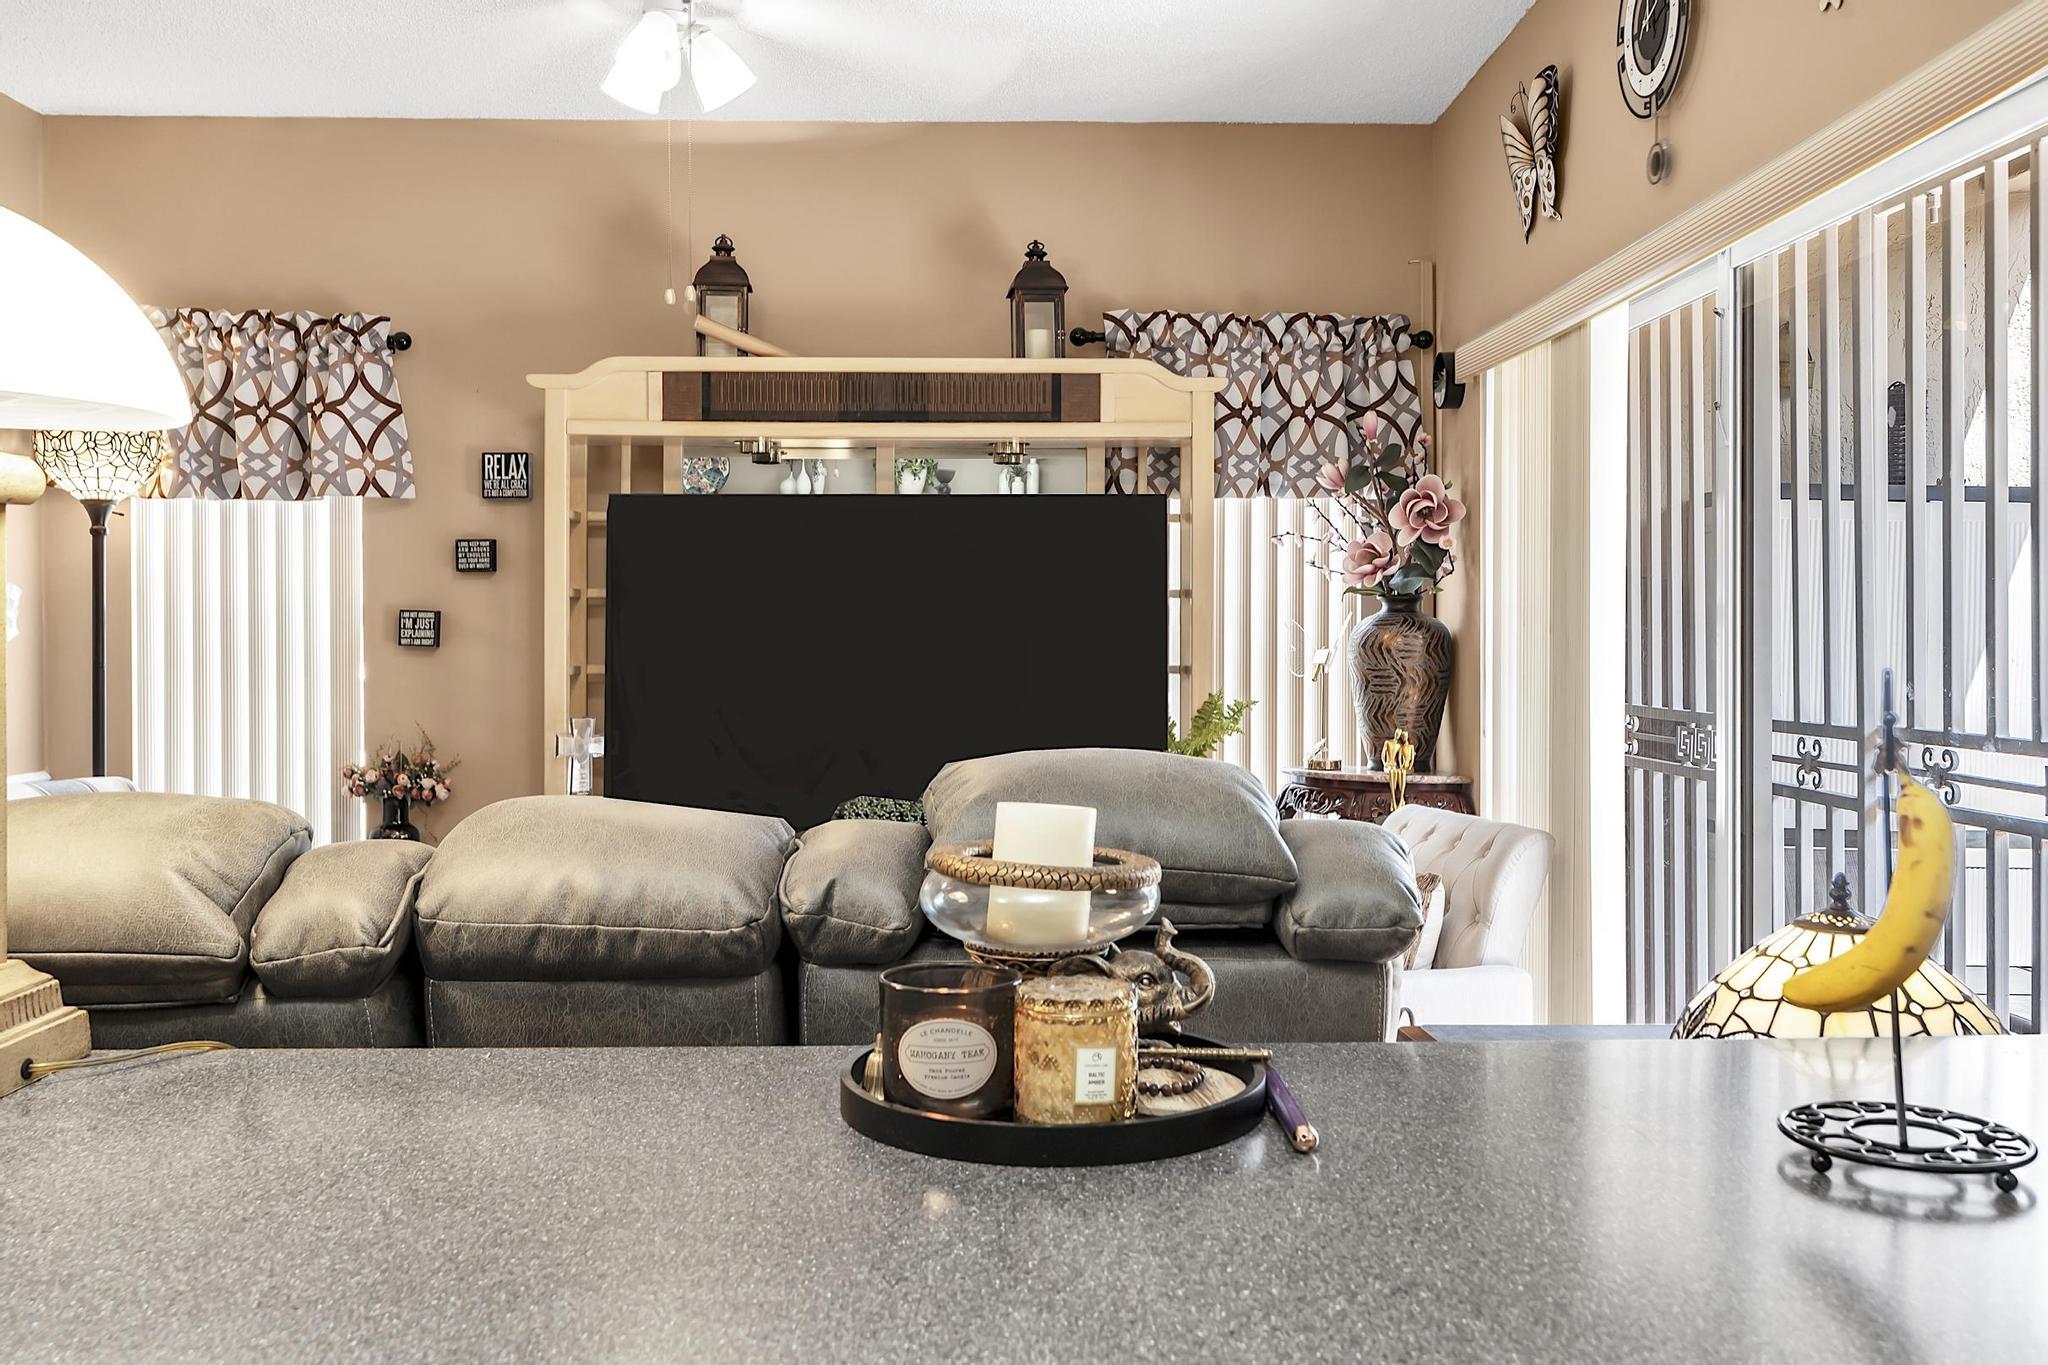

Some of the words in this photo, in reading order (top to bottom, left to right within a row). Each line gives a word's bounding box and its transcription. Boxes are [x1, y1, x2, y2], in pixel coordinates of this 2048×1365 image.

[484, 454, 527, 480] RELAX
[484, 479, 500, 489] WE'RE
[501, 479, 510, 489] ALL
[510, 479, 527, 489] CRAZY
[491, 489, 499, 497] NOT
[401, 618, 413, 629] I'M
[414, 618, 435, 629] JUST
[400, 629, 435, 638] EXPLAINING
[919, 1030, 928, 1038] LE
[929, 1028, 972, 1037] CHANDELLE
[909, 1049, 956, 1060] MAHOGANY
[961, 1048, 985, 1059] TEAK
